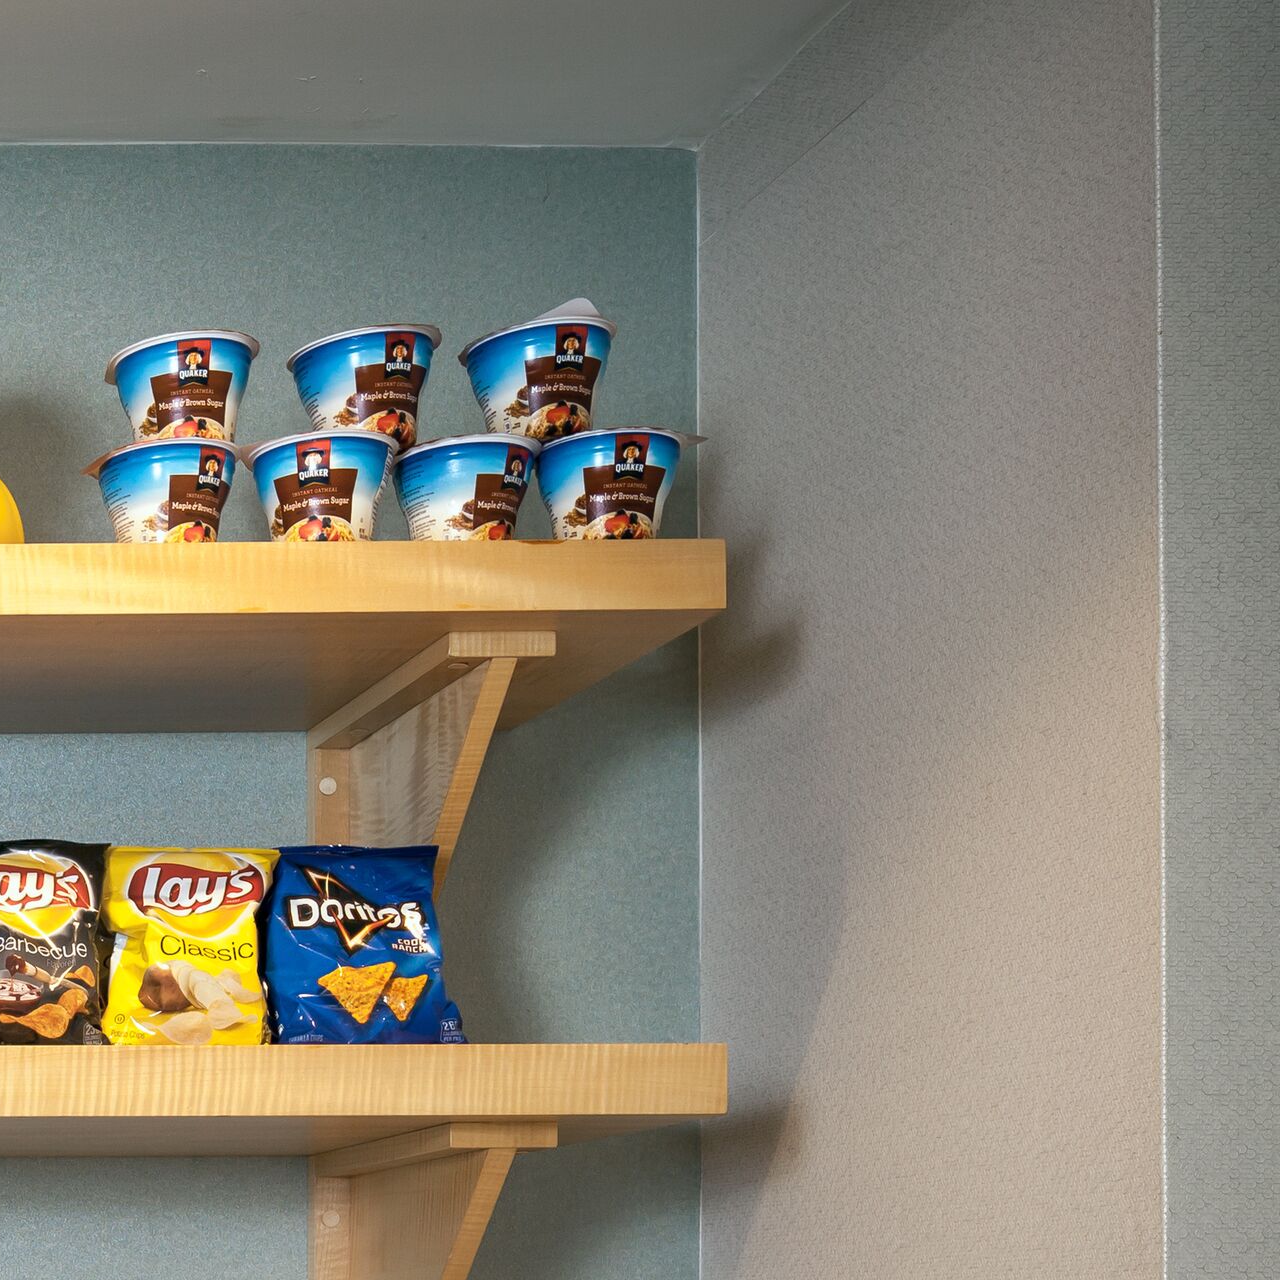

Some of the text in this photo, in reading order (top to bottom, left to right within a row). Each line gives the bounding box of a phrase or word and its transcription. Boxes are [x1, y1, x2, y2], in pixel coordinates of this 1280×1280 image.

[556, 354, 584, 364] QUAKER
[386, 361, 411, 372] QUAKER
[179, 369, 208, 379] QUAKER
[158, 399, 224, 411] Maple Brown Sugar
[615, 462, 644, 473] QUAKER
[299, 468, 328, 480] QUAKER
[198, 474, 220, 487] QUAKER
[590, 492, 639, 503] Maple Brown
[172, 501, 191, 511] Maple
[283, 496, 350, 512] Maple Brown Sugar
[142, 865, 255, 917] Lay's
[289, 897, 421, 930] Doritos
[160, 934, 255, 962] Classic
